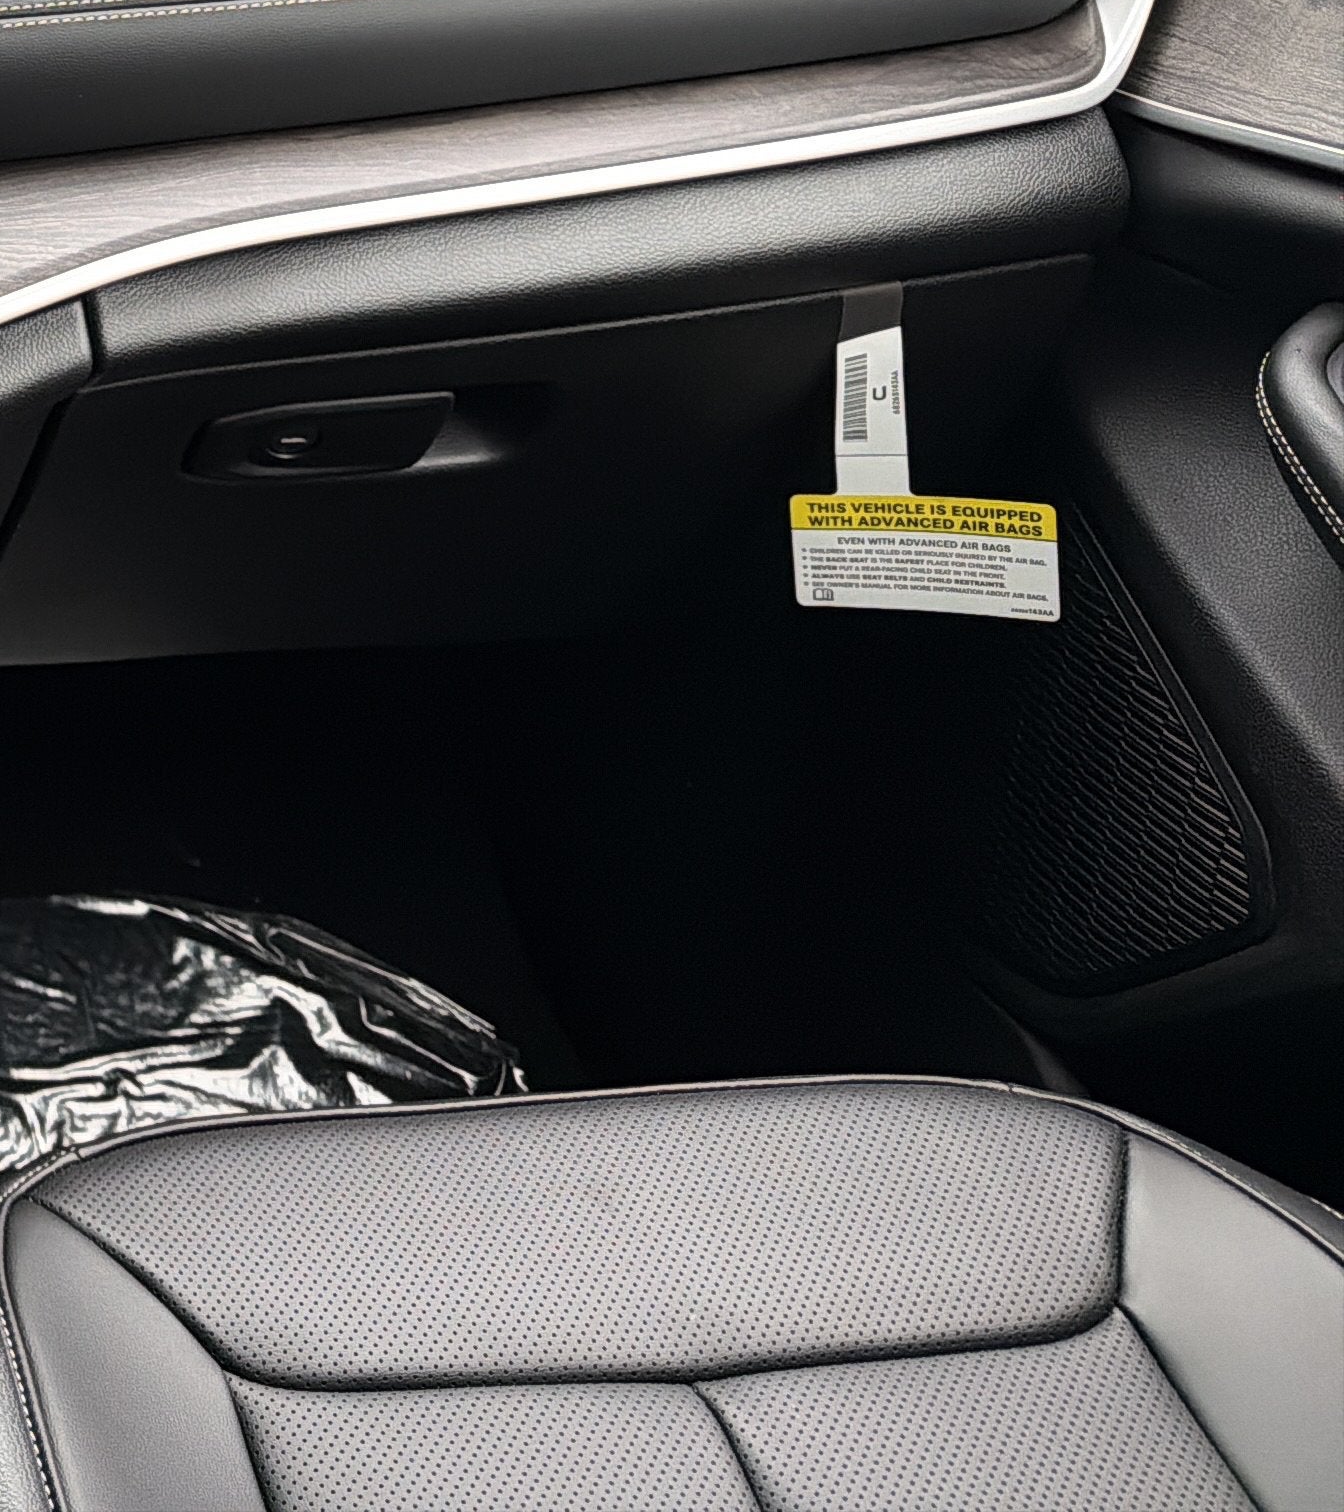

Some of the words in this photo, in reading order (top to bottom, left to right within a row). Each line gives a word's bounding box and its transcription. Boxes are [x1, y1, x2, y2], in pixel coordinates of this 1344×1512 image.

[873, 386, 886, 400] C
[806, 502, 847, 513] THIS
[850, 503, 925, 515] VEHICLE
[930, 504, 946, 514] IS
[952, 505, 1042, 522] EQUIPPED
[807, 515, 853, 526] WITH
[857, 516, 954, 529] ADVANCED
[960, 520, 989, 532] AIR
[994, 522, 1042, 536] BAGS
[837, 537, 865, 545] EVEN
[868, 537, 895, 546] WITH
[898, 538, 957, 548] ADVANCED
[960, 541, 979, 550] AIR
[982, 542, 1011, 552] BAGS
[914, 550, 954, 558] SERIOUSLY
[979, 572, 1006, 580] FRONT.
[933, 586, 983, 595] INFORMATION
